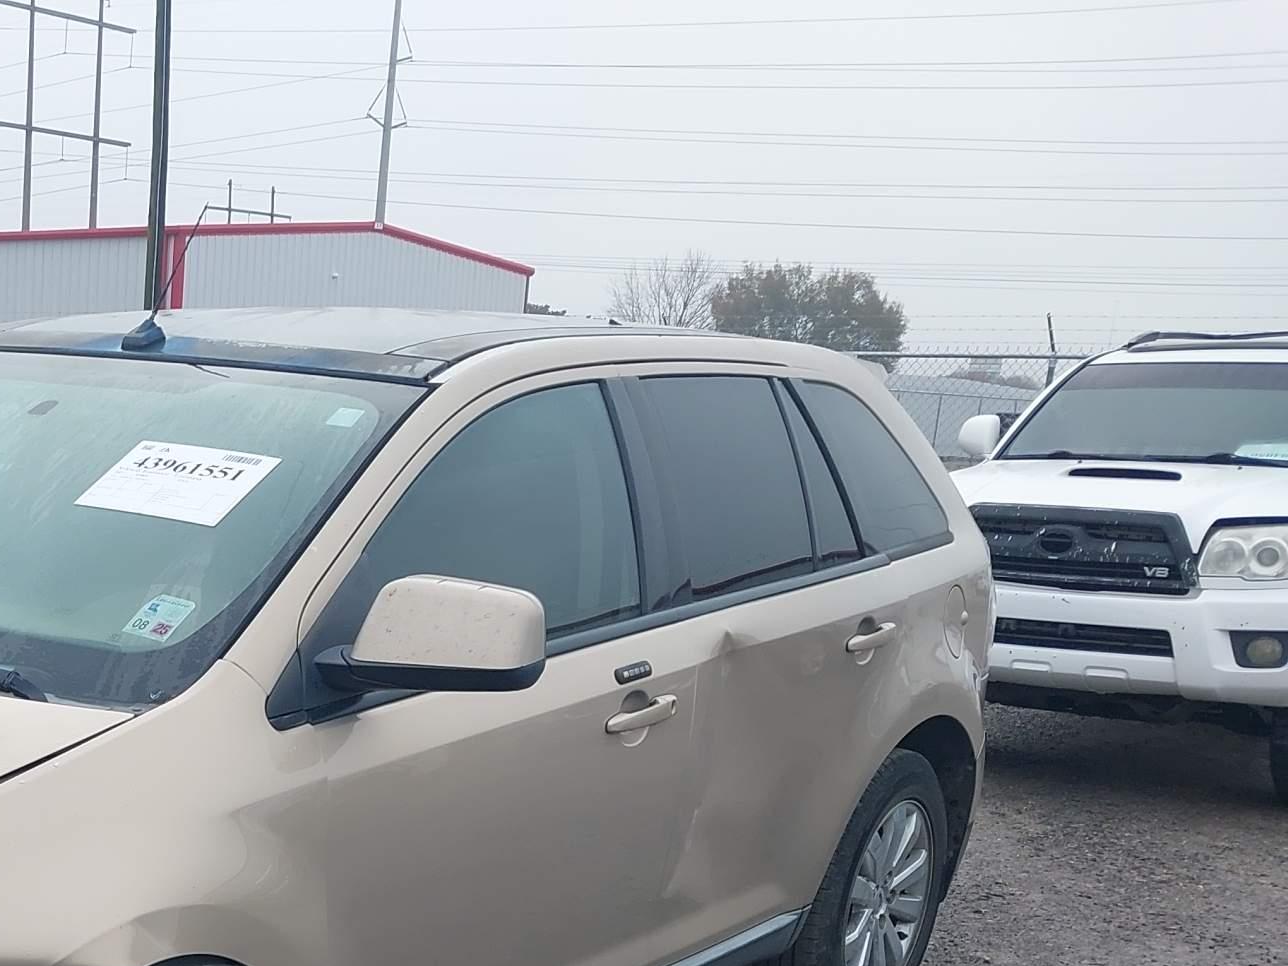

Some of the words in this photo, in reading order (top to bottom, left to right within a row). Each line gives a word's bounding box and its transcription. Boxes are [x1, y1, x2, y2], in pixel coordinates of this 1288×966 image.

[133, 456, 246, 481] 43961551
[1143, 566, 1169, 578] V8
[132, 618, 150, 631] 08
[150, 623, 172, 635] 25
